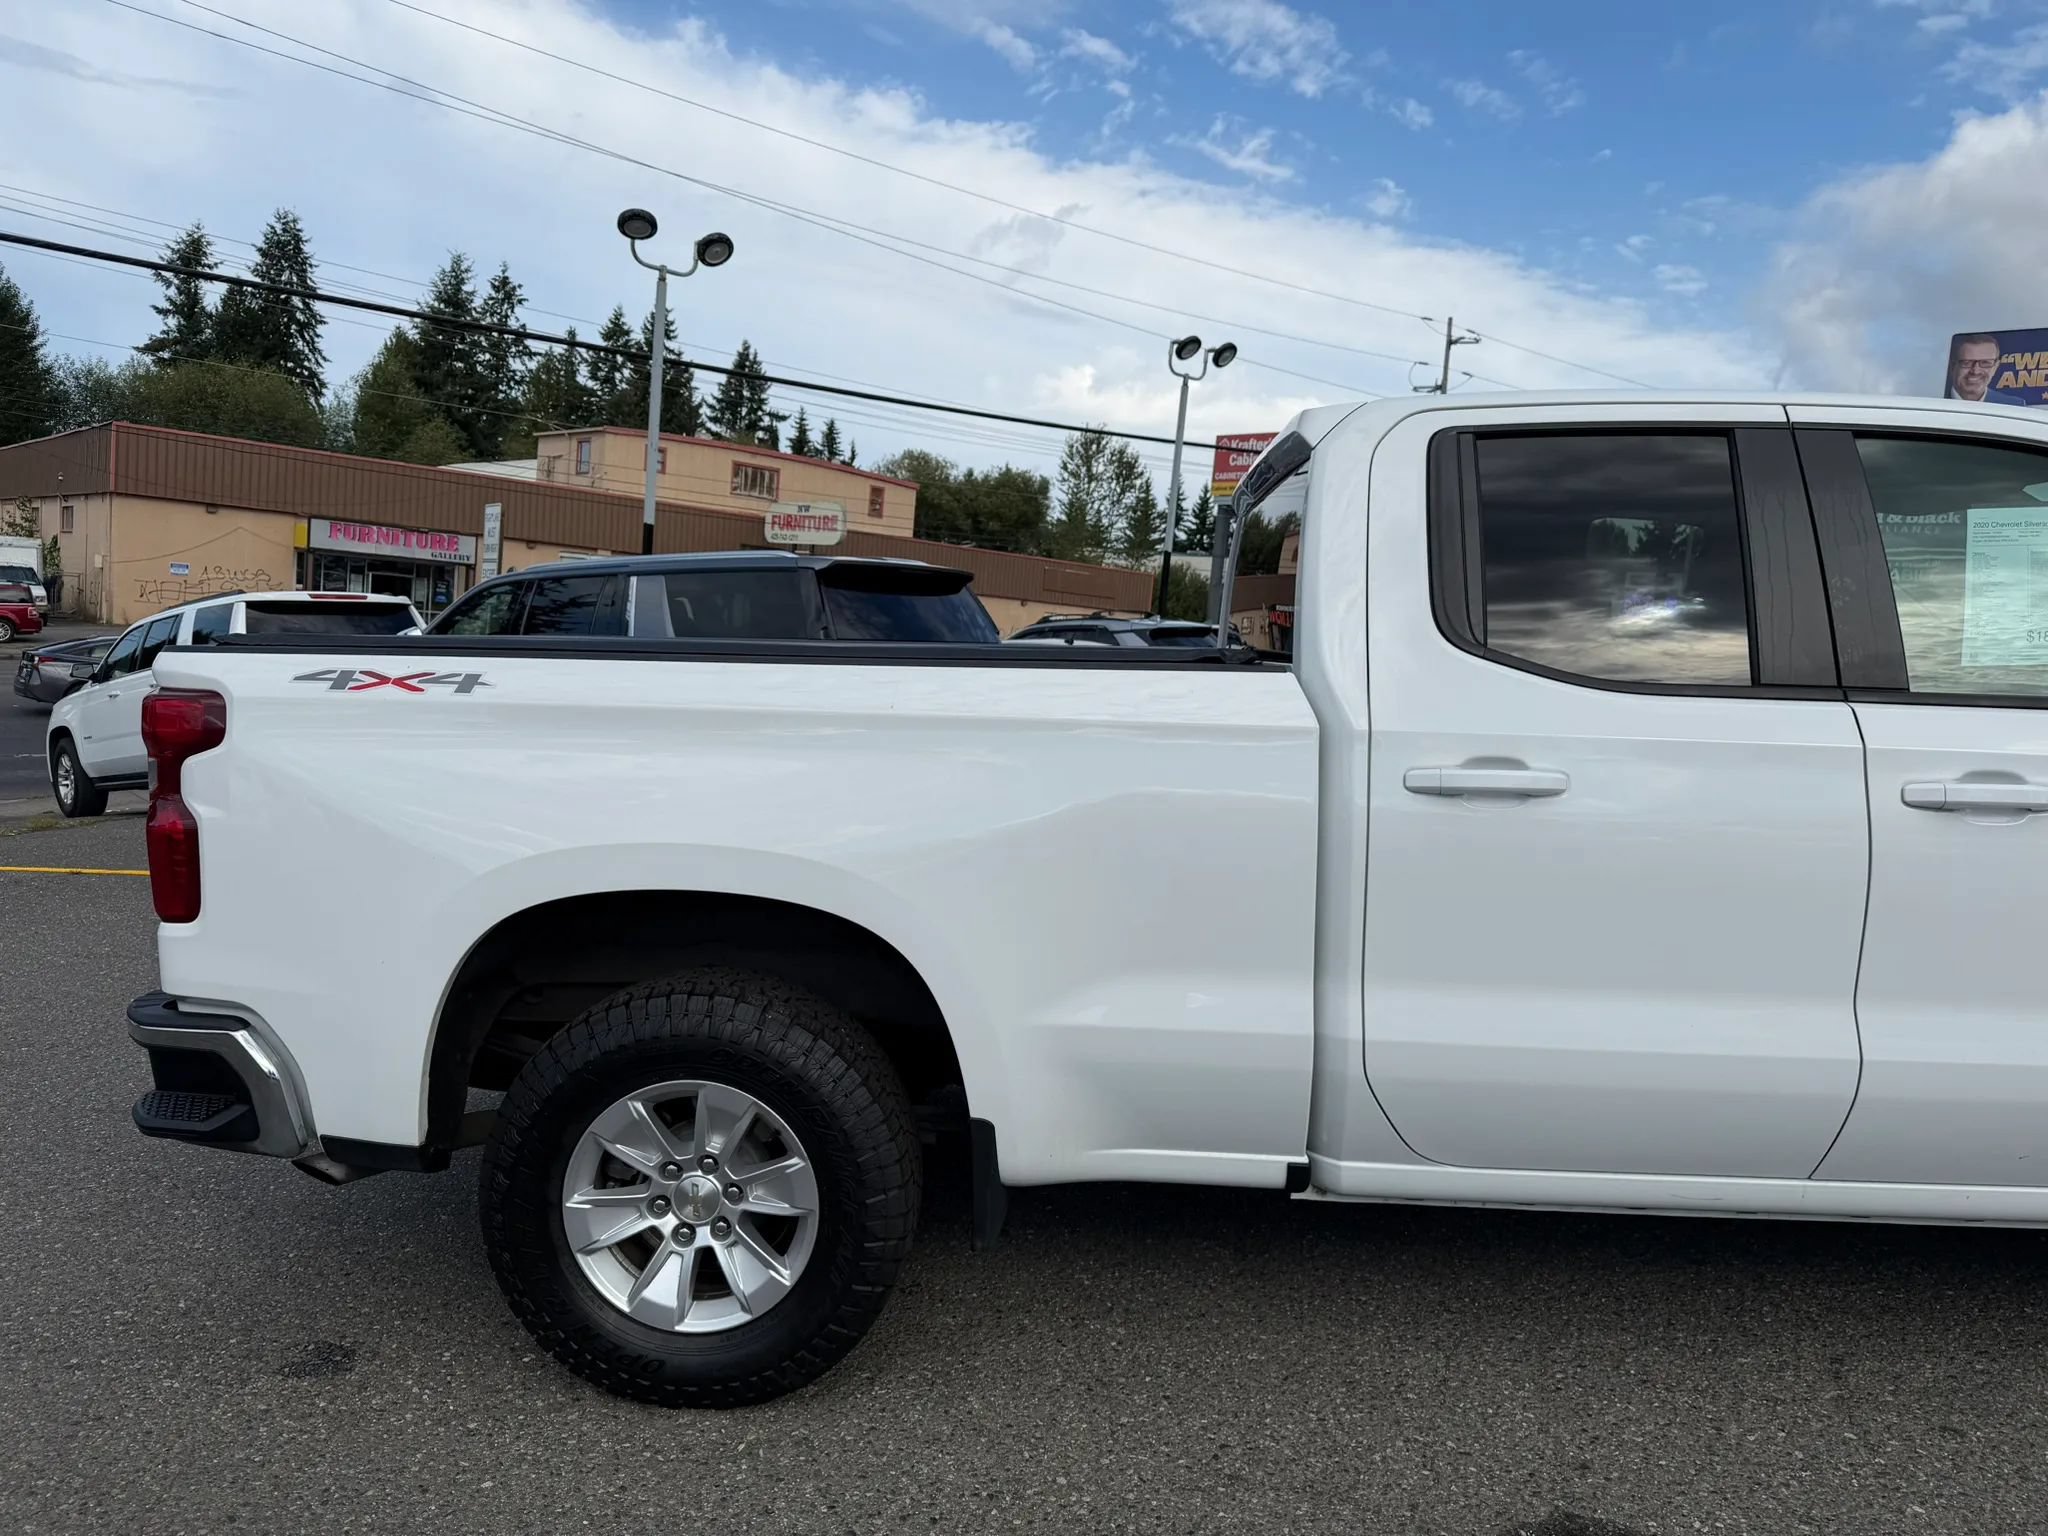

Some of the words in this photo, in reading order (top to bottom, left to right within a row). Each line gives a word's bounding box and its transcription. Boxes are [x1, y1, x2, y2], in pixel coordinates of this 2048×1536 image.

[797, 505, 811, 513] NW
[771, 515, 839, 532] FURNITURE
[329, 521, 460, 552] FURNITURE
[430, 551, 472, 562] GALLERY
